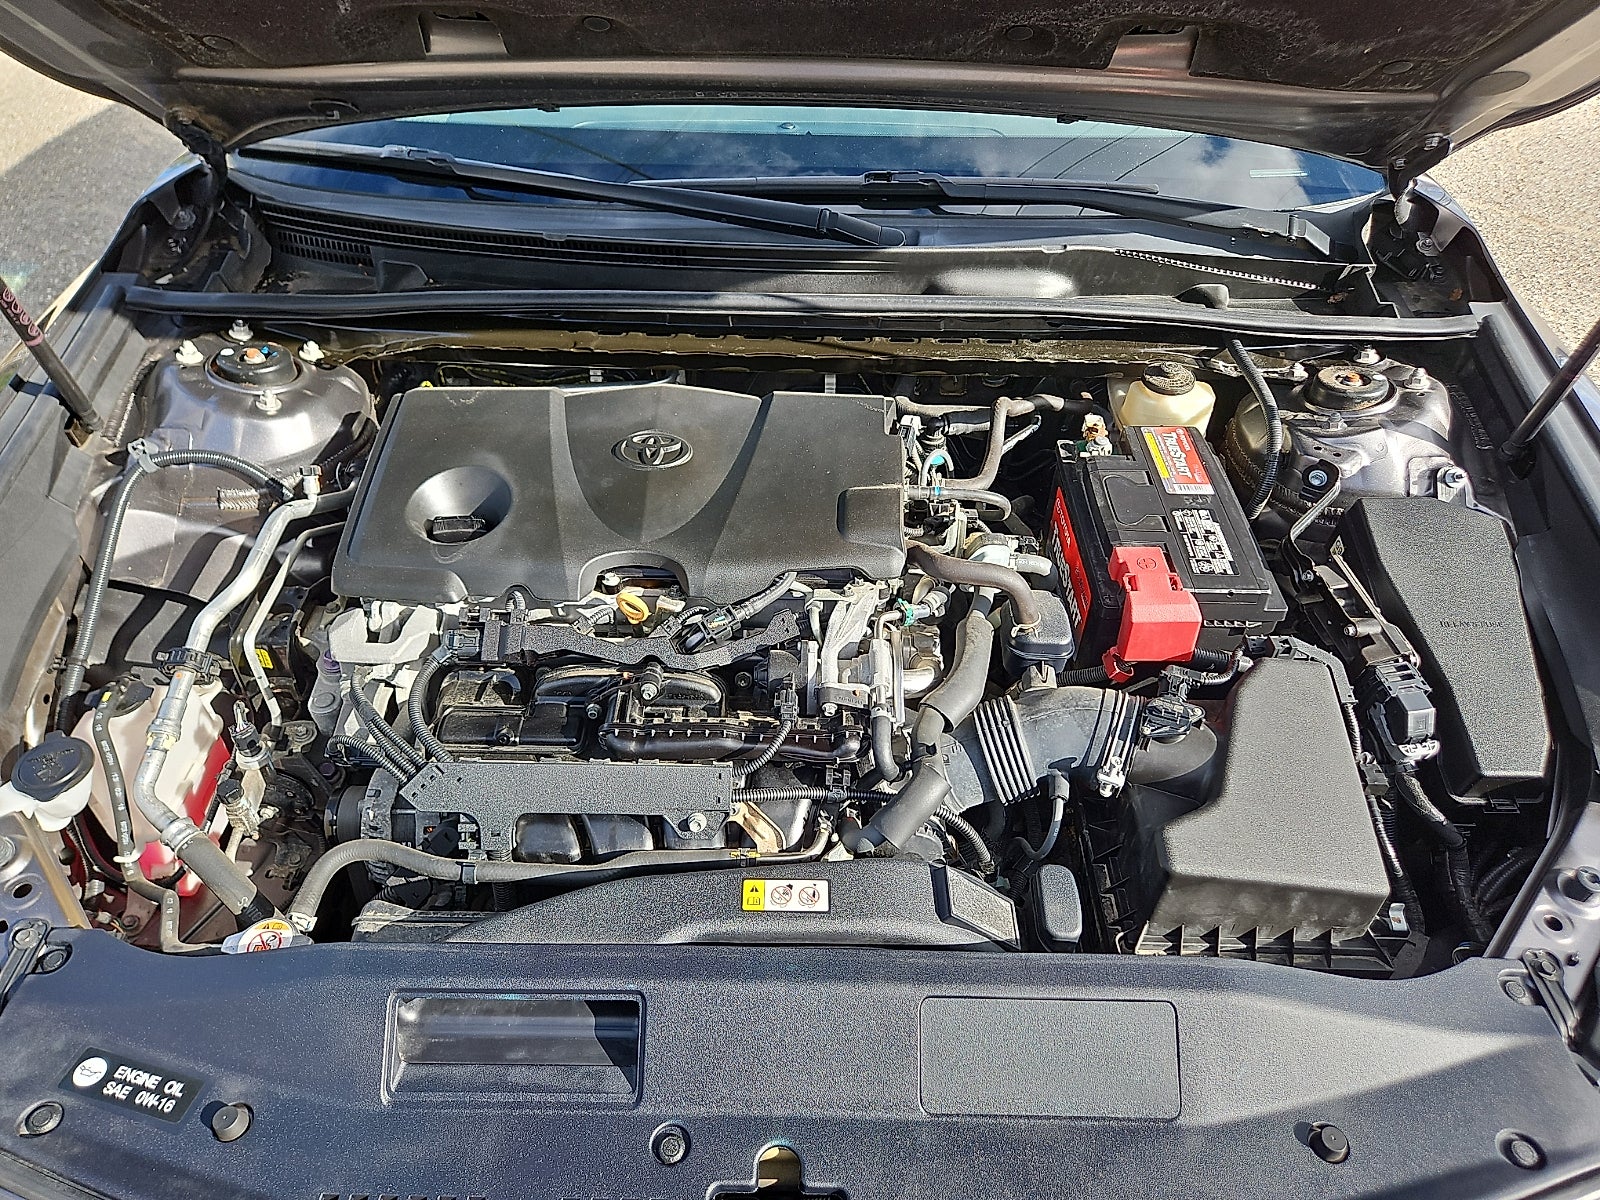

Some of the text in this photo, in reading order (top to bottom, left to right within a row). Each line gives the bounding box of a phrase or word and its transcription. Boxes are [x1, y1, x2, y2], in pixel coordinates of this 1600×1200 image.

[103, 1081, 176, 1113] SAE 0W-16
[113, 1065, 185, 1098] ENGINE OIL
